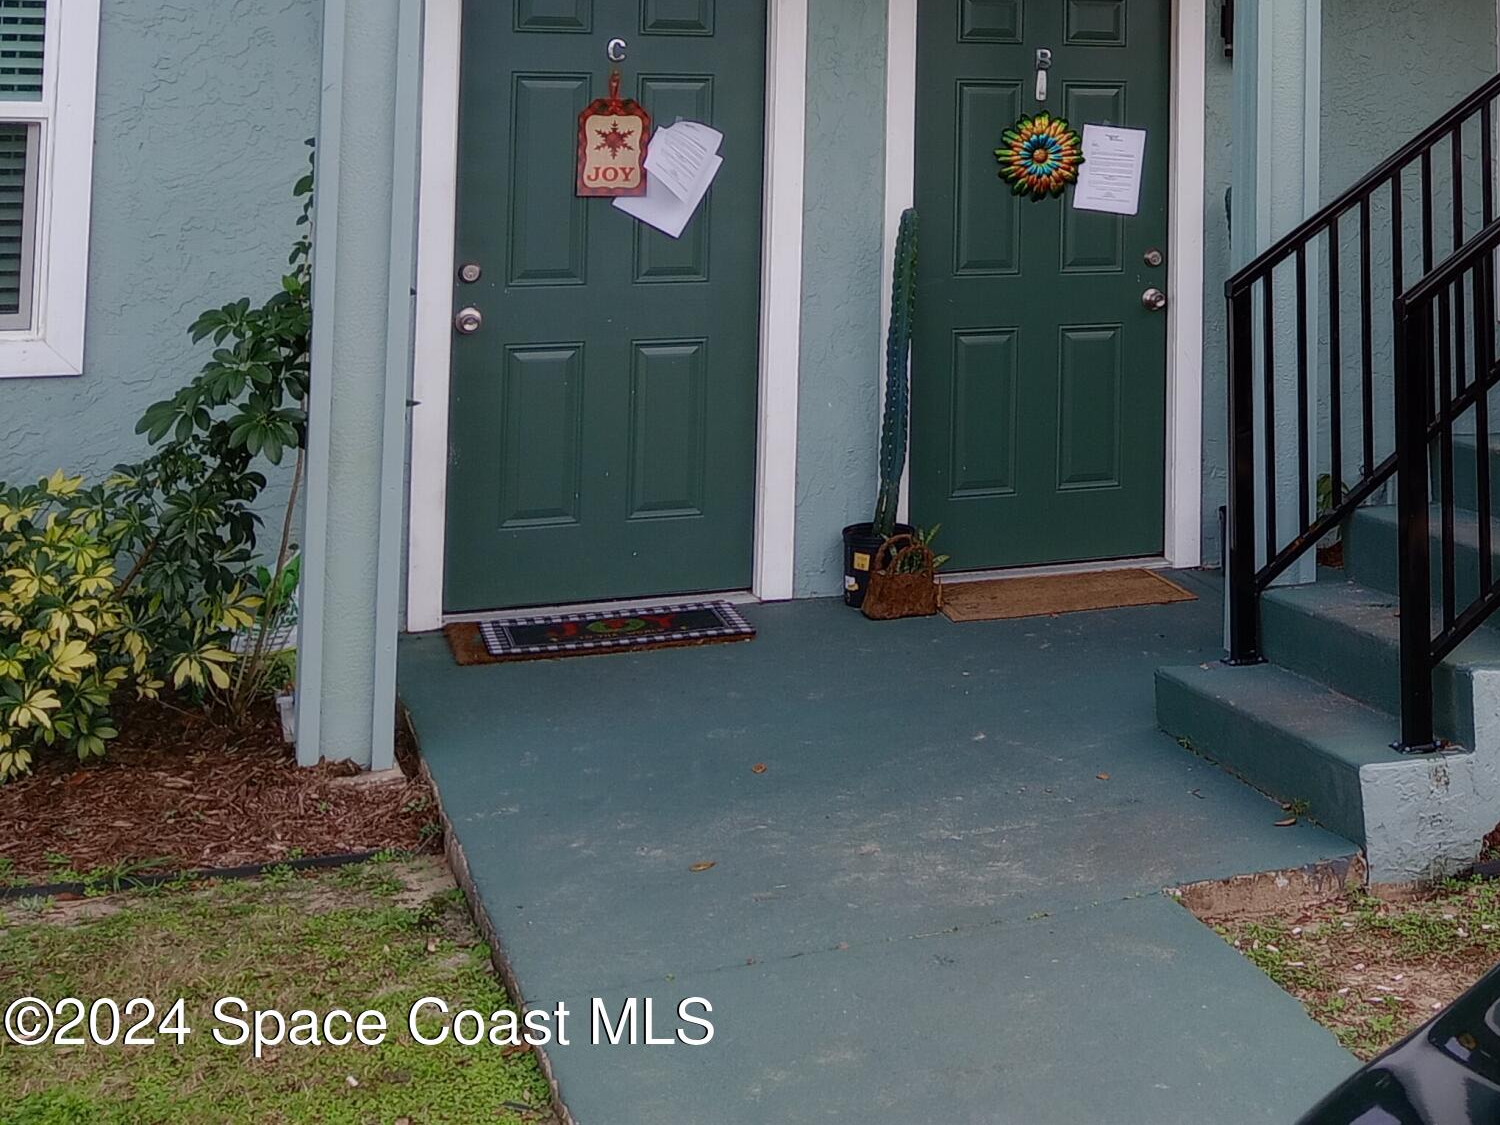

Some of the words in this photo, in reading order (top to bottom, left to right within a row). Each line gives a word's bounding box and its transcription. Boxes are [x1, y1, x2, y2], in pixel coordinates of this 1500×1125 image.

[608, 38, 626, 61] C
[1035, 48, 1052, 69] B
[587, 166, 635, 182] JOY
